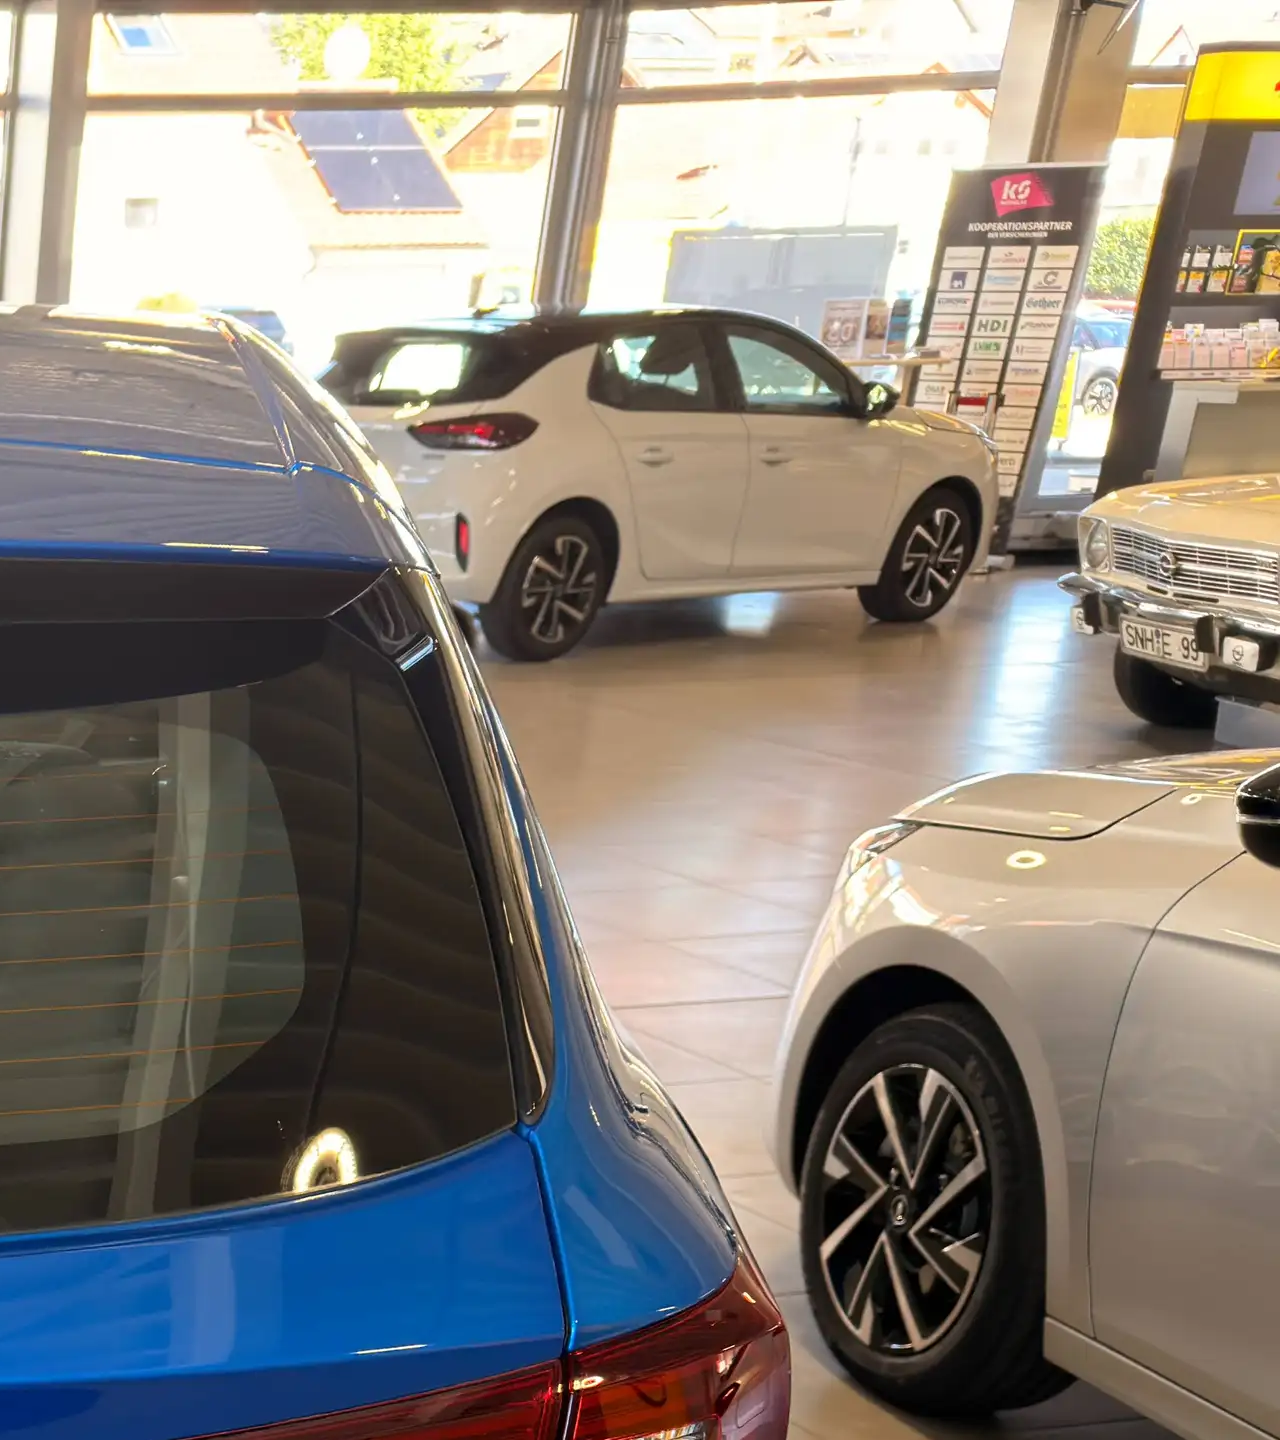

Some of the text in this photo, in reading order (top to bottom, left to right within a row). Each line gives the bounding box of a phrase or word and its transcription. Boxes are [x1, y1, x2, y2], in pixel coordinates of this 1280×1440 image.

[968, 221, 1073, 232] KOOPERATIONSPARTNER
[1025, 297, 1062, 311] Gothaer
[977, 319, 1008, 333] HDI
[1126, 624, 1155, 651] SNH
[1163, 633, 1173, 657] E
